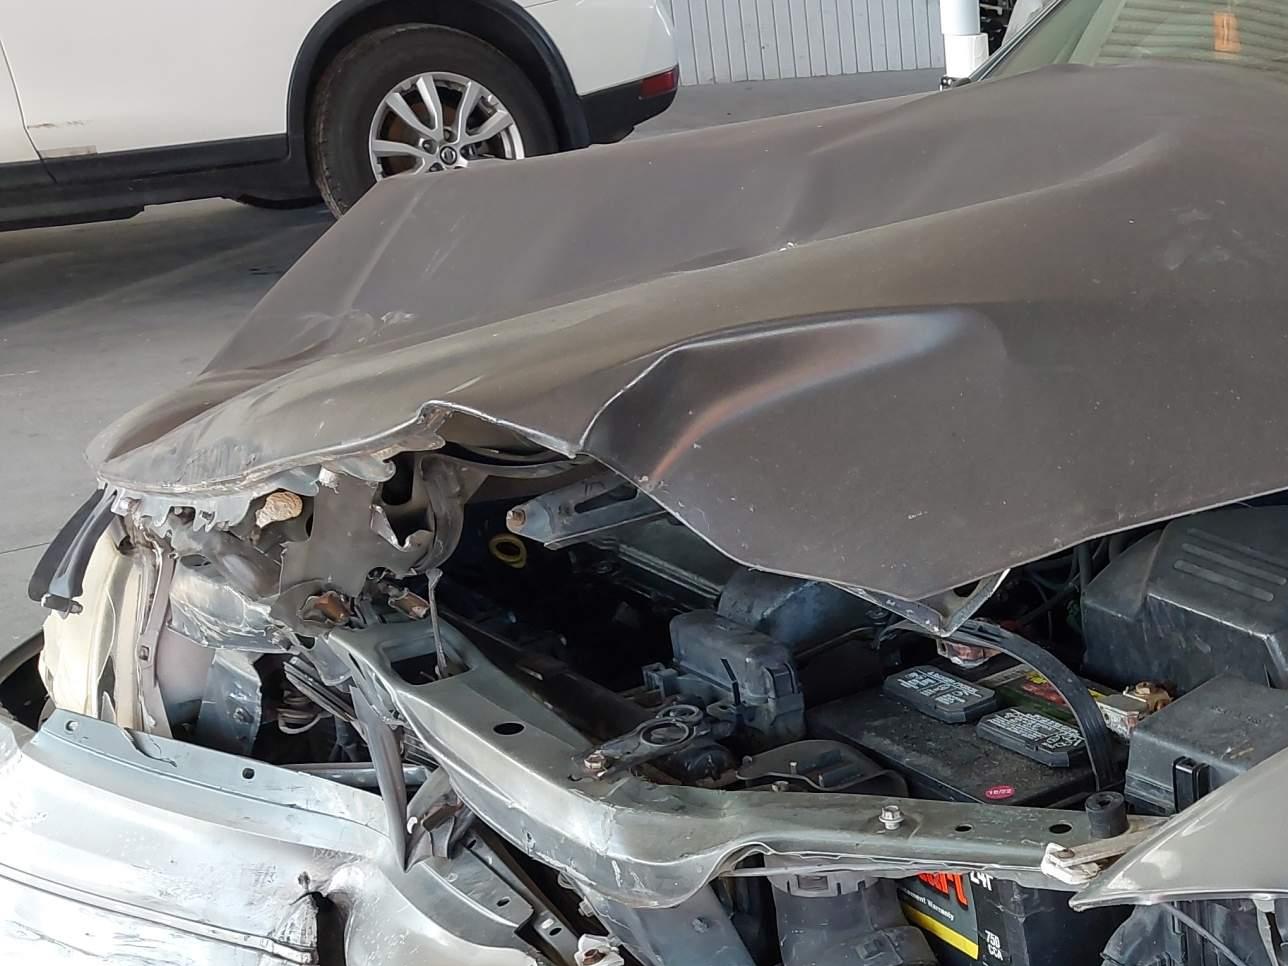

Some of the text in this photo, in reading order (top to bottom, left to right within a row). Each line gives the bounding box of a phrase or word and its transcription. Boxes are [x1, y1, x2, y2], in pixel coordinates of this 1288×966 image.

[927, 896, 955, 921] Warranty
[984, 929, 1001, 949] 750
[987, 943, 1004, 961] CCA
